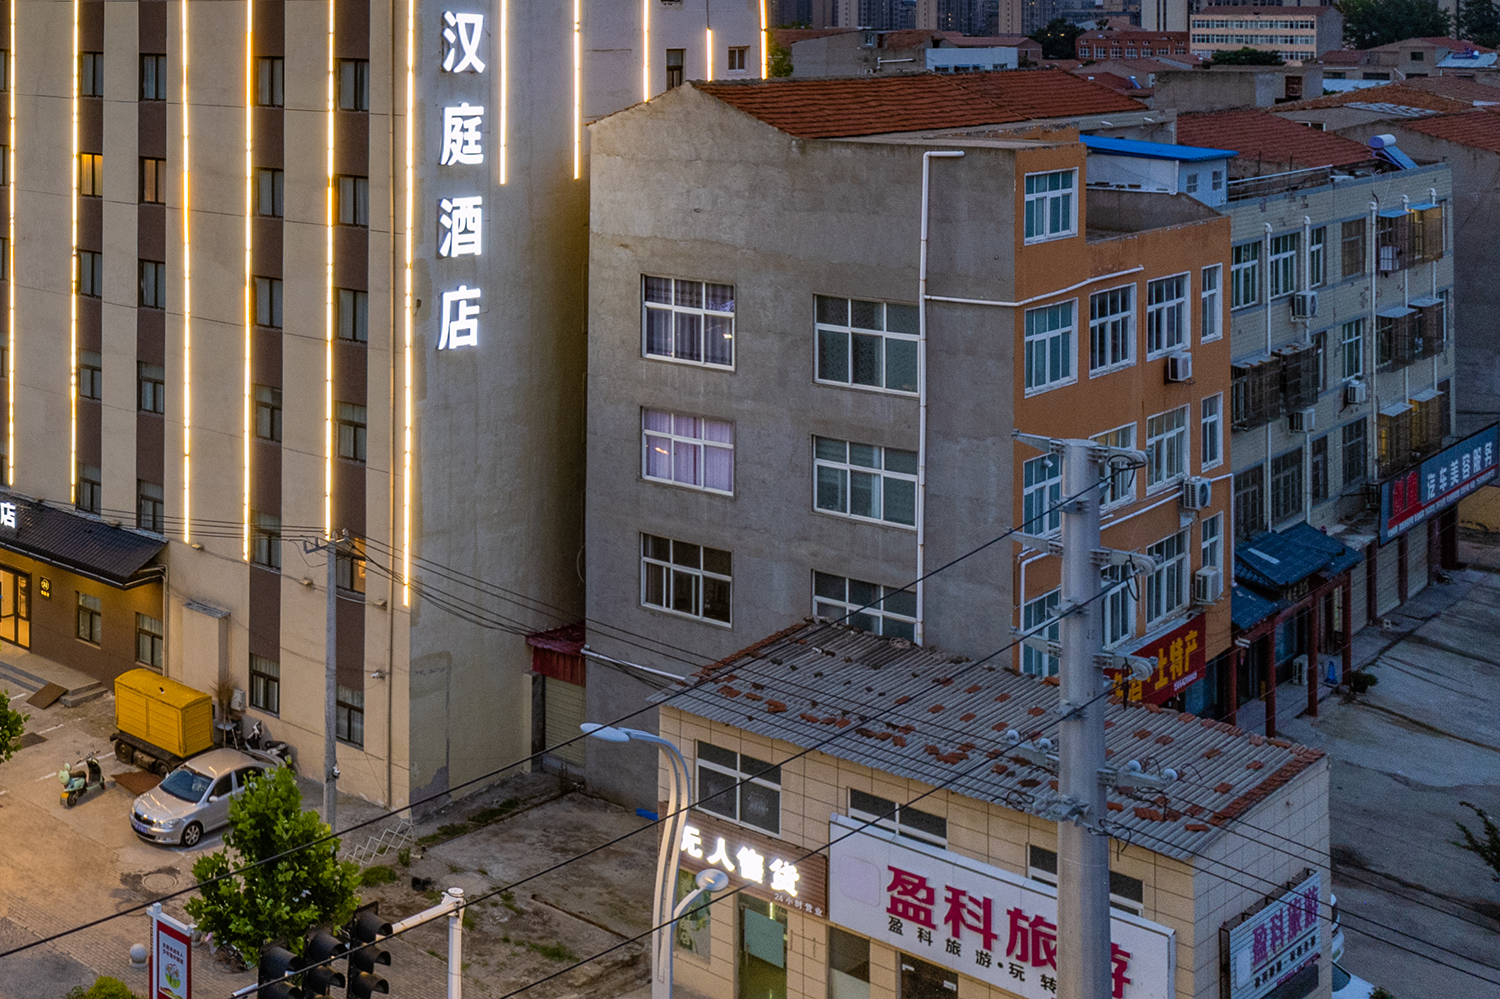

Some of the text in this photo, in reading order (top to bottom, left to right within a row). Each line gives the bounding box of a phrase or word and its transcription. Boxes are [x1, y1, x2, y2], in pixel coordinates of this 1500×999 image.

[438, 10, 485, 351] 汉庭酒店
[1427, 441, 1493, 501] 汽车美容服务
[774, 893, 824, 917] 24小时营业
[1252, 885, 1319, 967] 盈科旅游
